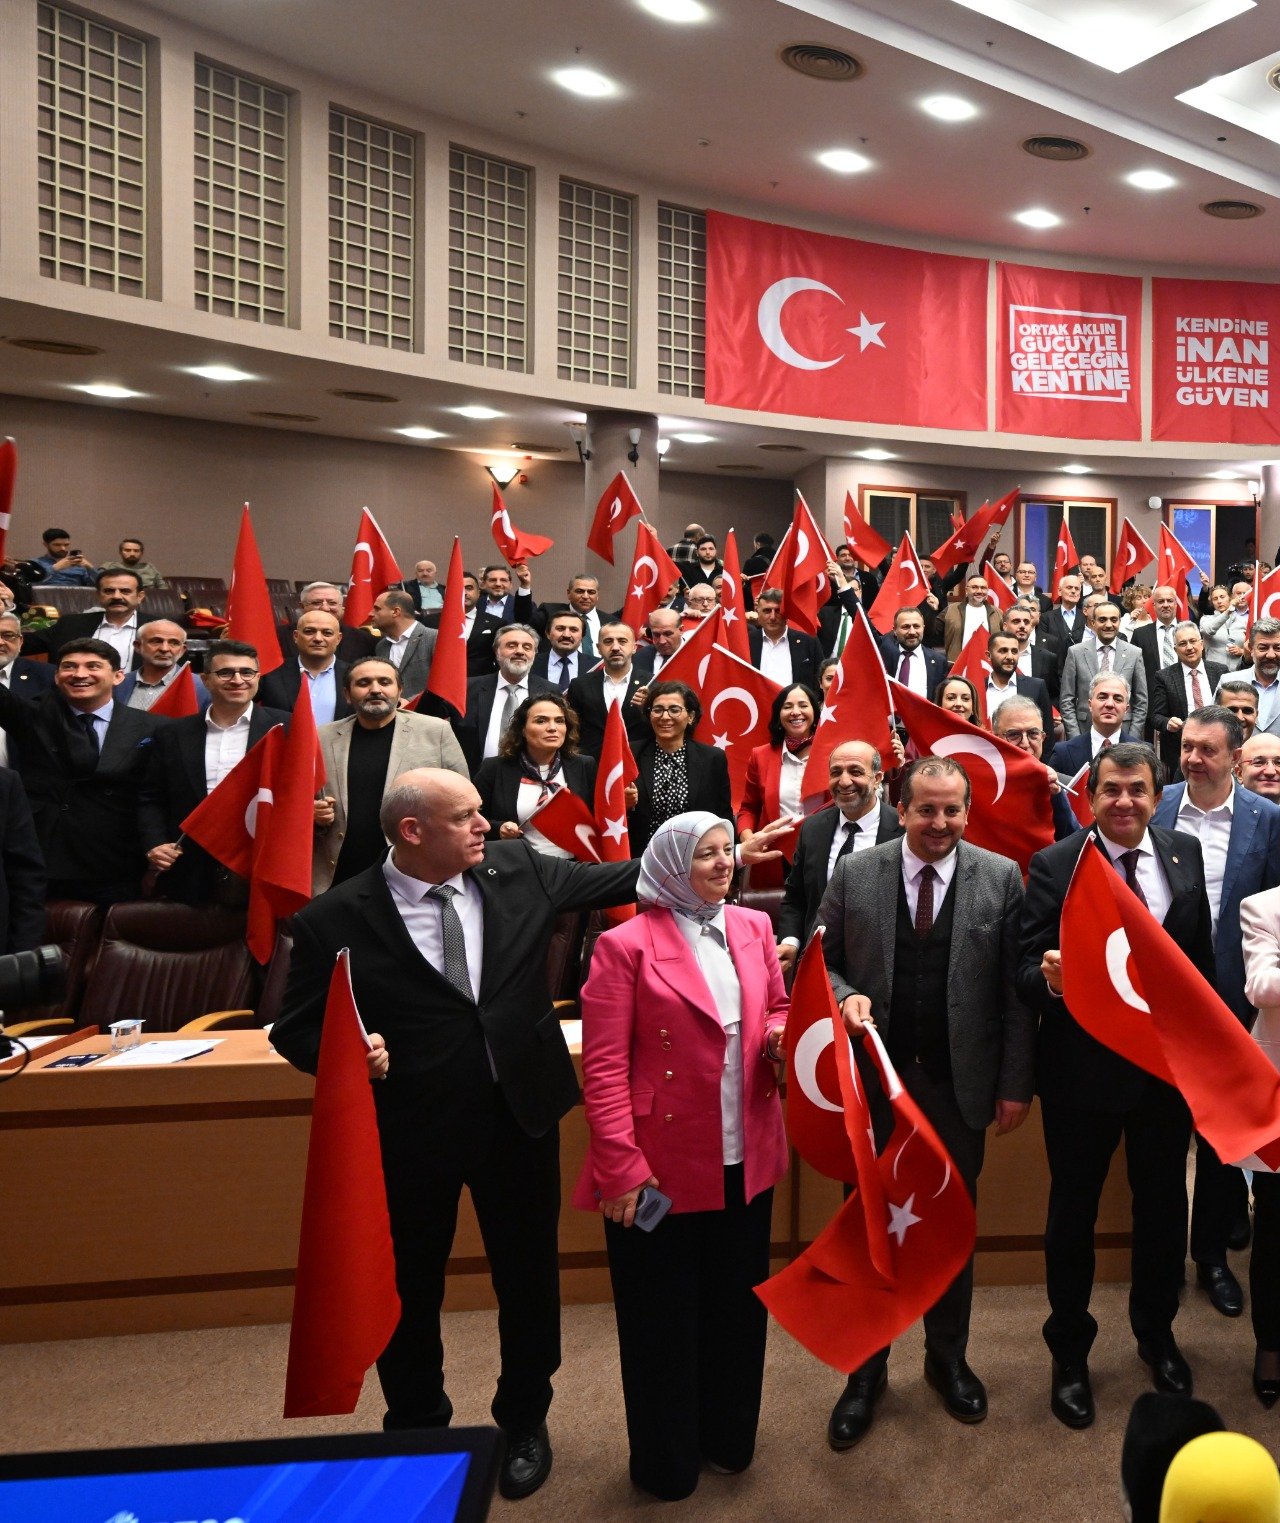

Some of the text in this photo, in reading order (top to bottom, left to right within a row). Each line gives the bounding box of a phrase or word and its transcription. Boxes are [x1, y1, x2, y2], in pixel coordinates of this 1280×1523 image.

[1018, 323, 1116, 336] ORTAK AKLIN
[1176, 317, 1269, 336] KENDİNE
[1176, 336, 1269, 365] İNAN
[1011, 369, 1131, 392] KENTİNE
[1176, 366, 1269, 386] ÜLKENE
[1176, 386, 1269, 408] GÜVEN
